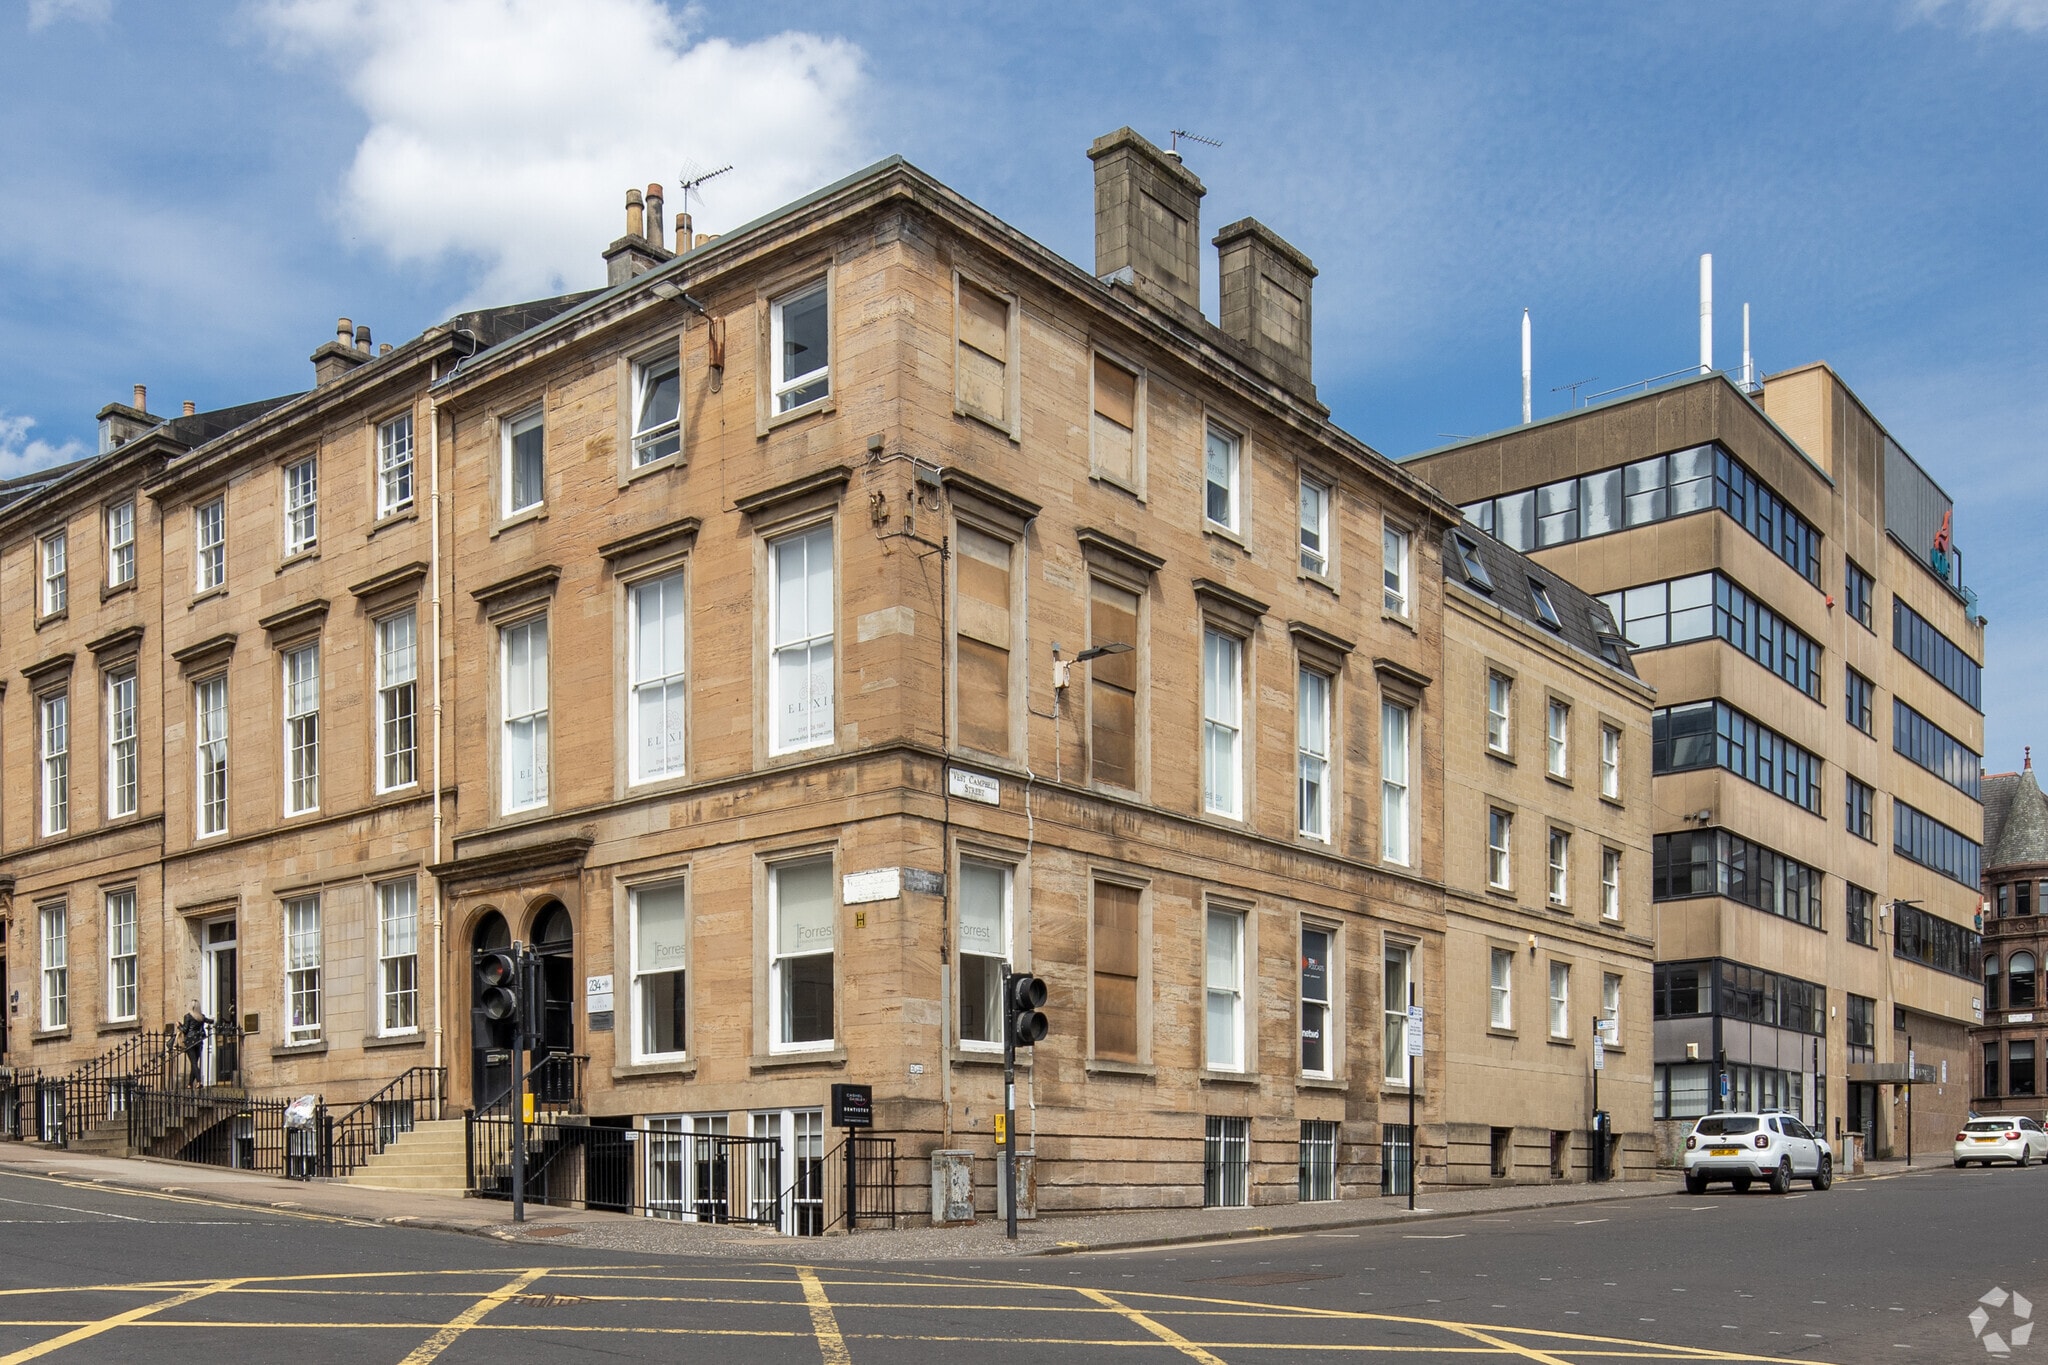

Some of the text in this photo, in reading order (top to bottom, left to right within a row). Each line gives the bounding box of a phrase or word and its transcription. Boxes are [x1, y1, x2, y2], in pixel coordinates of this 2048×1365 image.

[788, 694, 834, 714] ELXI
[647, 731, 682, 747] ELXI
[965, 784, 985, 796] STREET
[656, 943, 685, 957] Forres
[589, 979, 601, 991] 234
